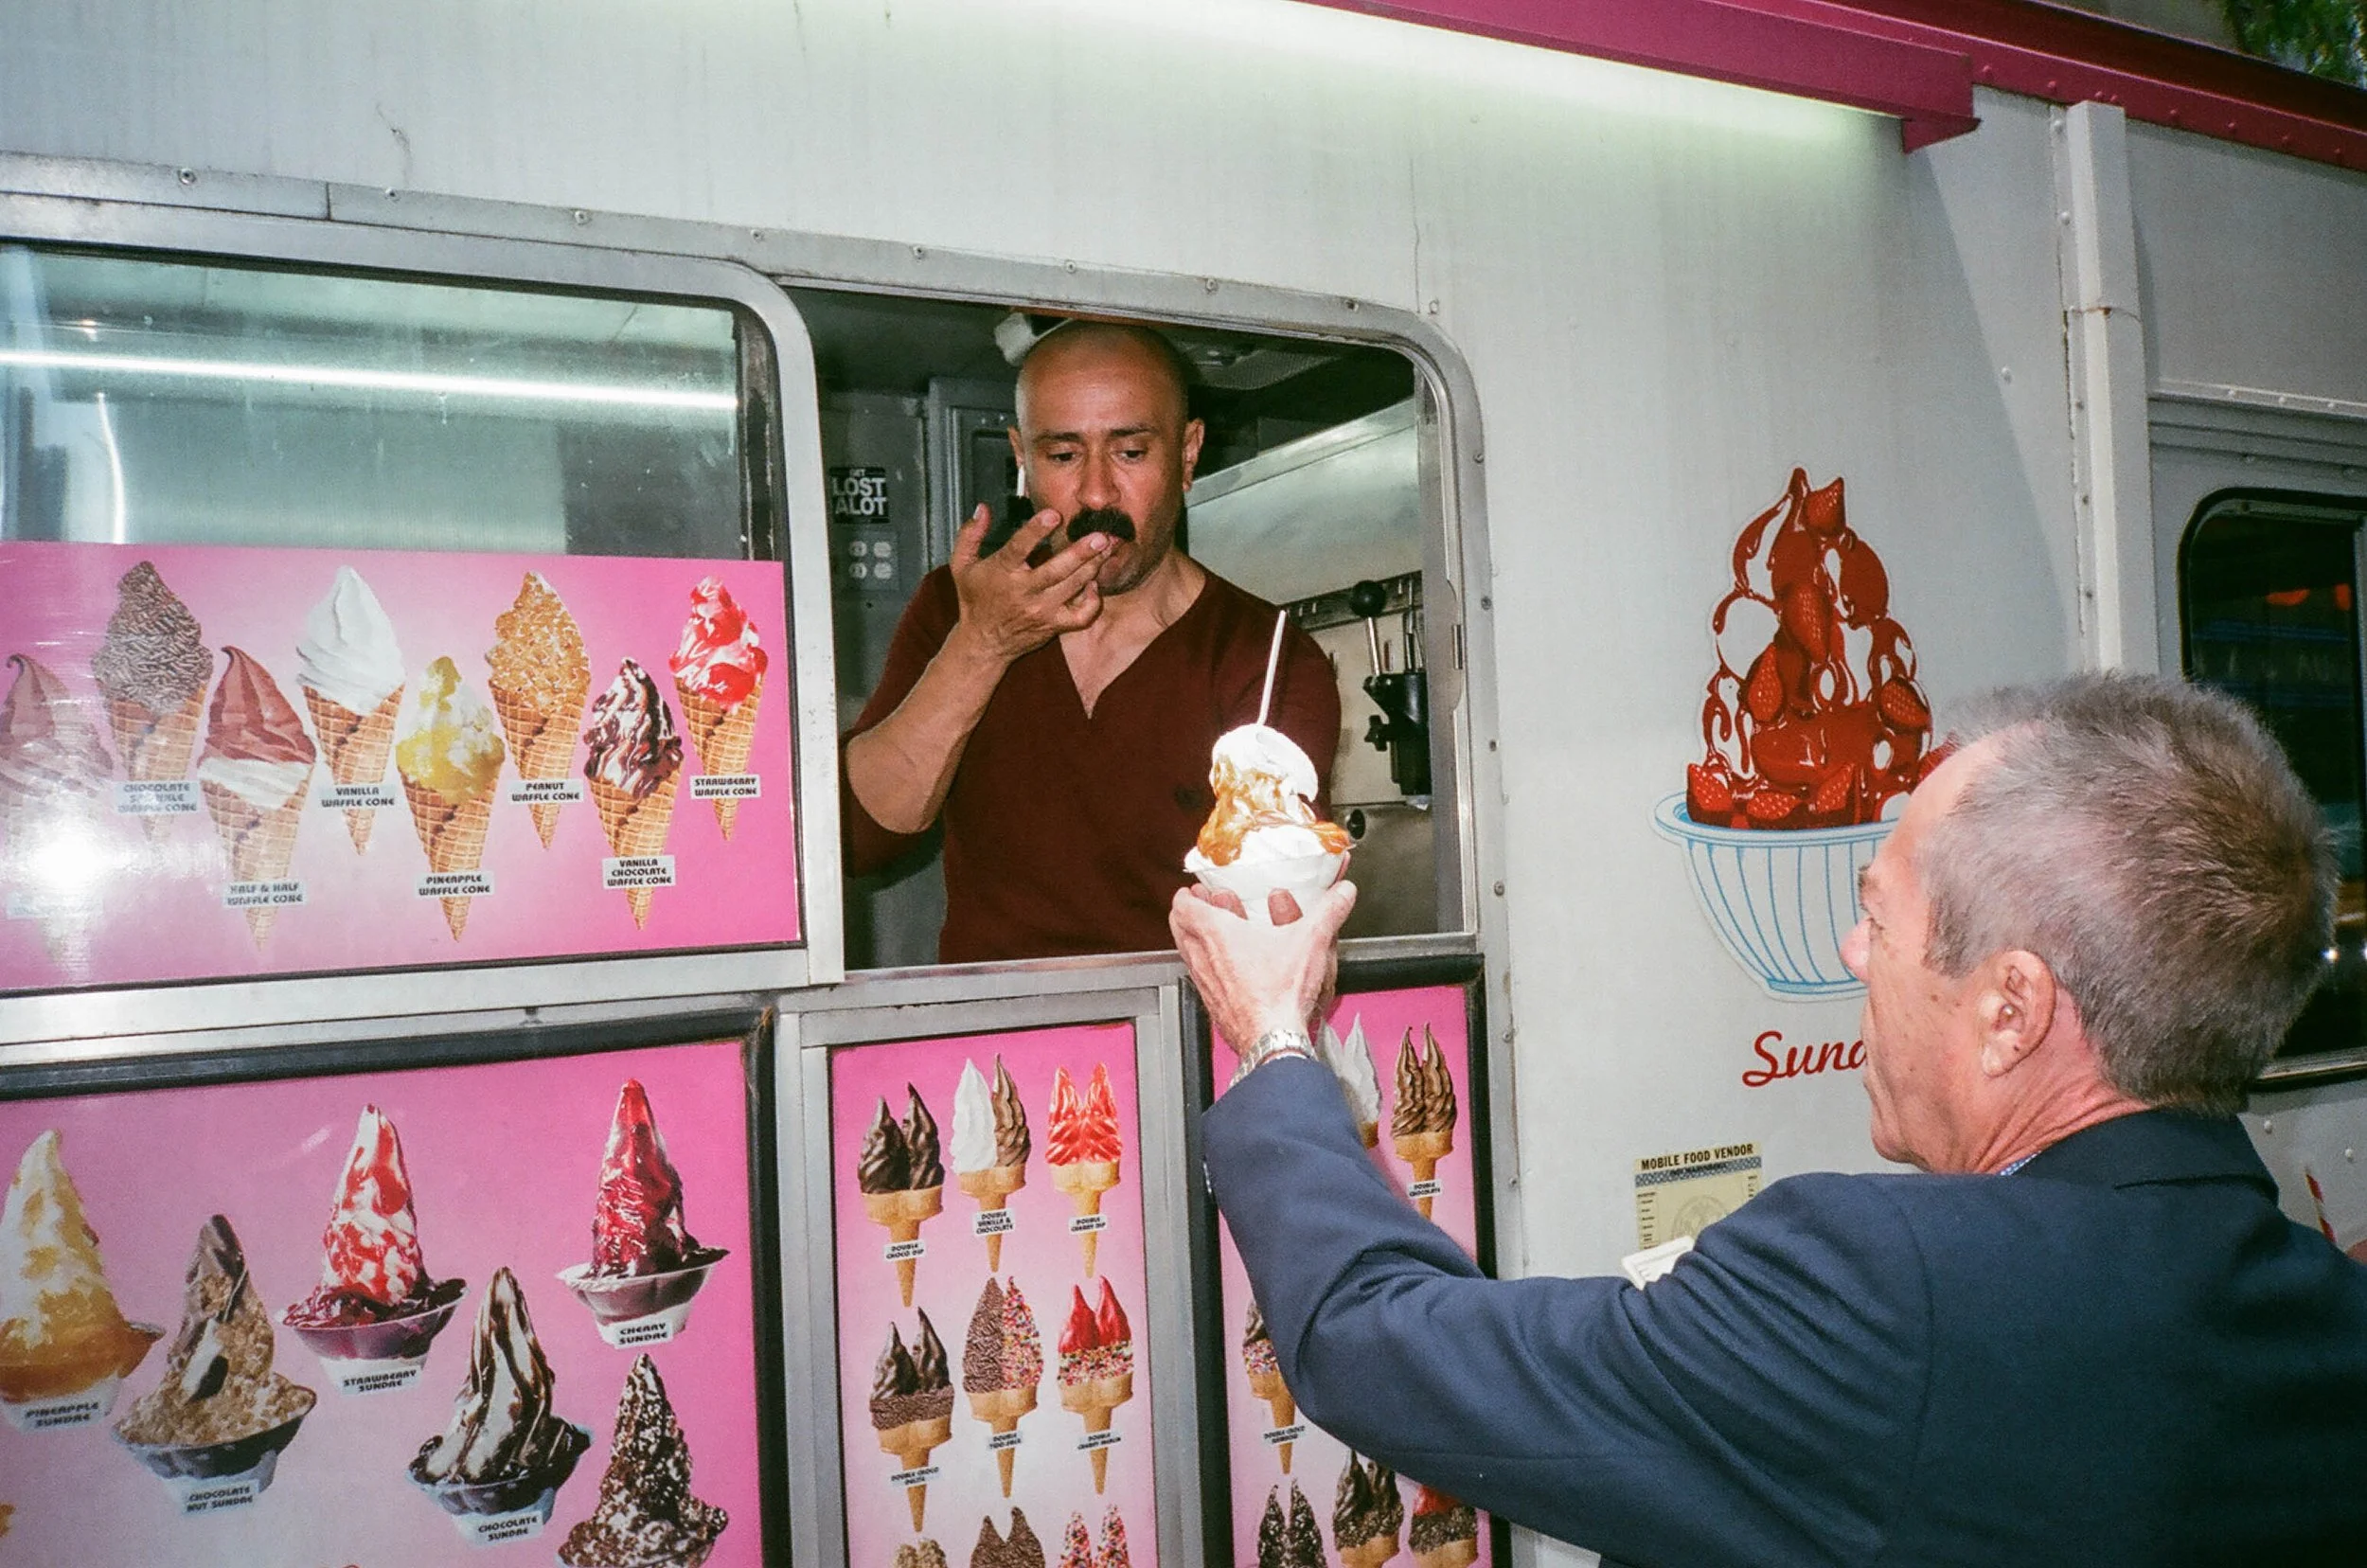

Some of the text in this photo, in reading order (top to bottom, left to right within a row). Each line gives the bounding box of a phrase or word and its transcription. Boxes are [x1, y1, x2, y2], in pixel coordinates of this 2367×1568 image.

[833, 477, 886, 497] LOST
[835, 496, 887, 516] ALOT
[525, 782, 564, 791] PEANUT
[695, 777, 756, 786] STRAWBERRY
[123, 783, 190, 793] CHOCOLATE
[335, 787, 380, 795] VANILLA
[695, 787, 757, 796] WAFFLE CONE
[321, 797, 395, 808] WAFFLE CONE
[511, 793, 579, 802] WAFFLE CONE
[165, 803, 197, 811] CONE
[619, 858, 658, 867] VANILLA
[612, 867, 667, 877] CHOCOLATE
[426, 874, 482, 883] PINEAPPLE
[607, 876, 672, 886] WAFFLE CONE
[230, 884, 256, 894] HALF
[273, 882, 299, 891] HALF
[418, 885, 490, 896] WAFFLE CONE
[227, 894, 303, 905] WAFFLE CONE
[1641, 1154, 1681, 1170] MOBILE
[1683, 1149, 1711, 1164] FOOD
[1714, 1143, 1754, 1159] VENDOR
[620, 1322, 666, 1335] CHERRY
[619, 1332, 667, 1345] SUNDAE
[344, 1369, 417, 1386] STRAWBERRY
[359, 1380, 402, 1392] SUNDAE
[26, 1401, 99, 1417] PINEAPPLE
[37, 1412, 91, 1427] SUNDAE
[189, 1486, 250, 1502] CHOCOLATE
[211, 1495, 253, 1508] SUNDAE
[478, 1516, 538, 1532] CHOCOLATE
[488, 1527, 528, 1541] SUNDAE
